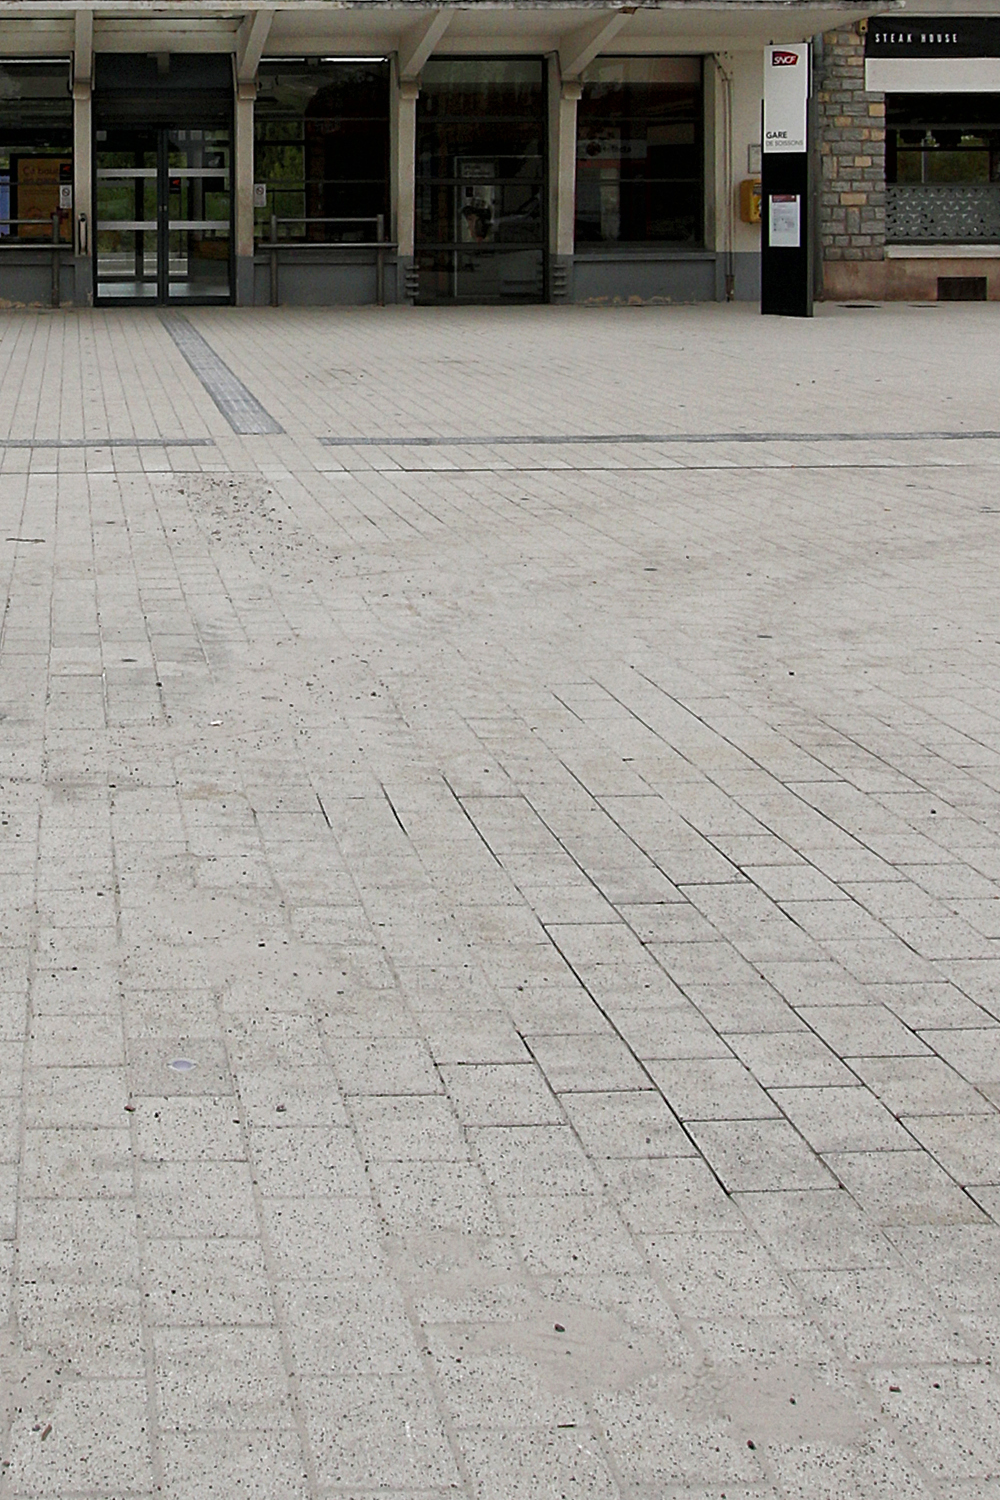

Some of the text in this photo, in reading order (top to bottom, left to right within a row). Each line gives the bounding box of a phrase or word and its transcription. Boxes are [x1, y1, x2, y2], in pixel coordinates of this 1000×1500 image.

[875, 33, 958, 43] STEAK HOUSE
[773, 55, 797, 65] SNCF
[766, 131, 787, 139] GARE
